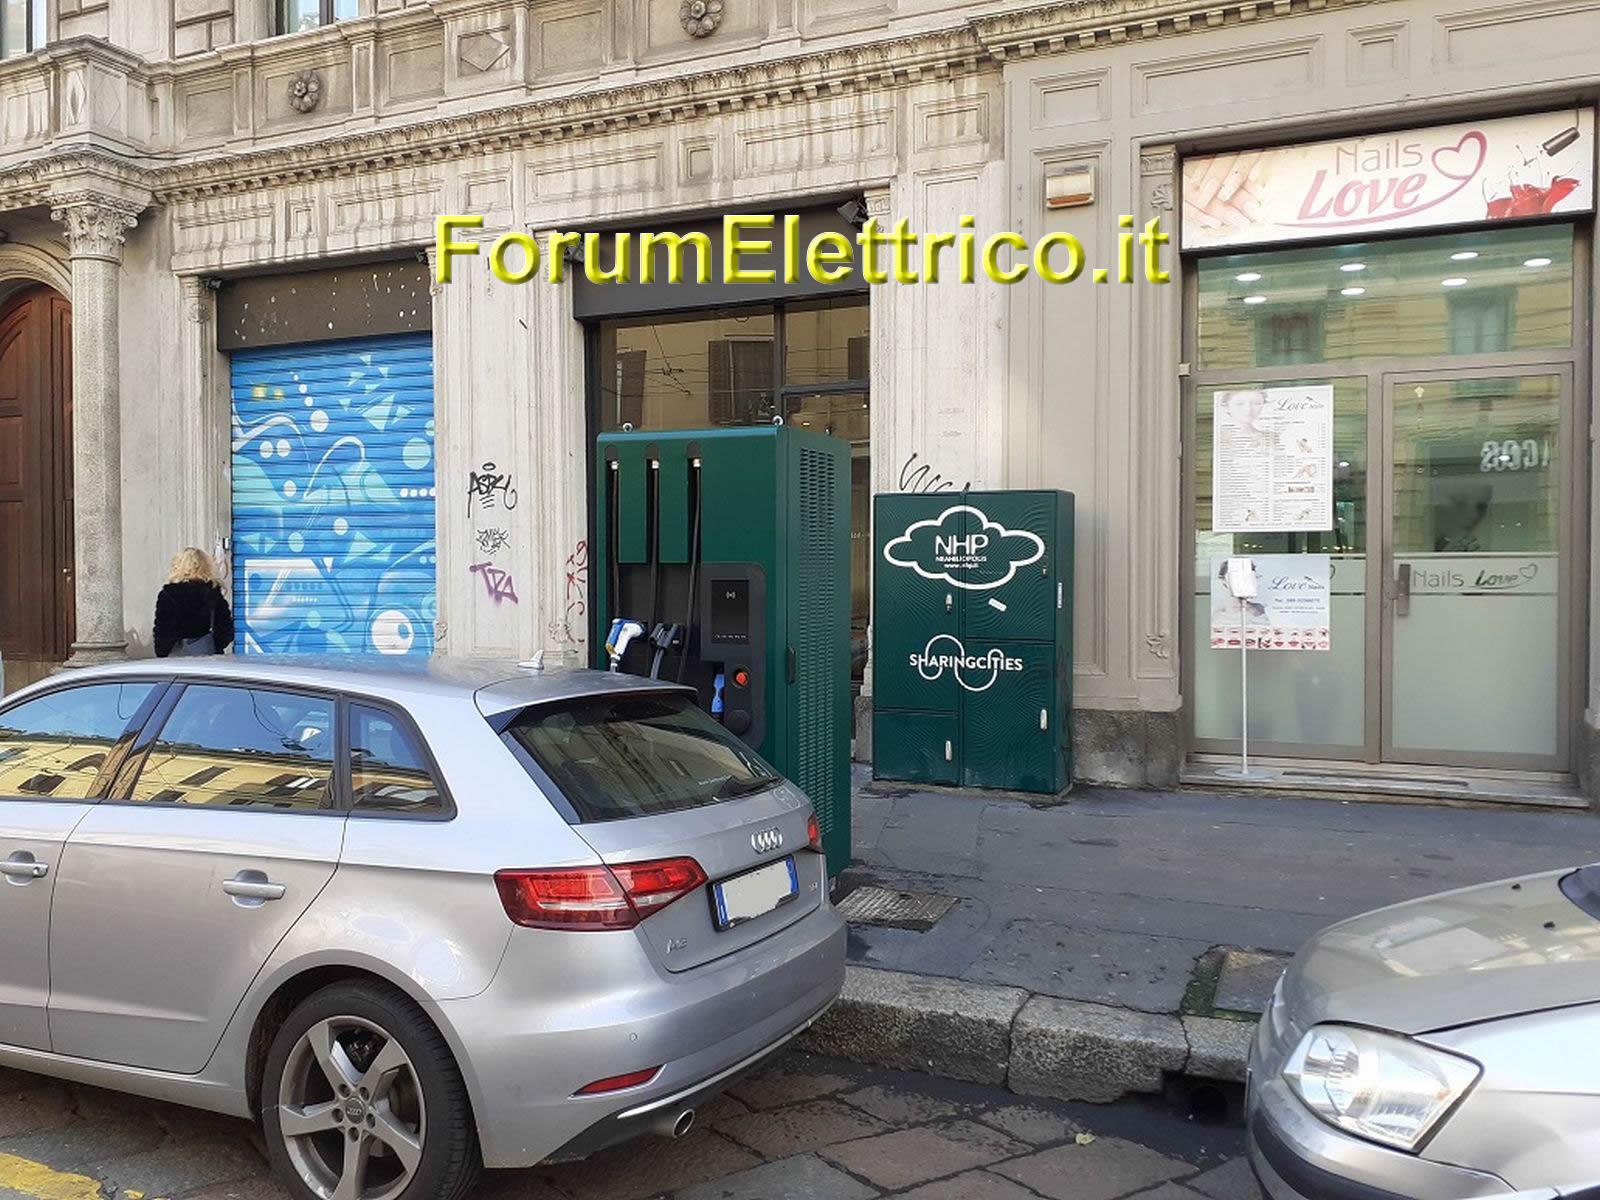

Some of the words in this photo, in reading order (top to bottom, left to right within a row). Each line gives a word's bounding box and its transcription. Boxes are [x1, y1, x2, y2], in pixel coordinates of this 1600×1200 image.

[1335, 139, 1423, 175] Nails
[1297, 170, 1427, 221] Love
[935, 534, 989, 555] NHP
[1413, 569, 1465, 588] Nails
[1475, 569, 1519, 587] Love
[909, 653, 1023, 671] SHARINGCITIES
